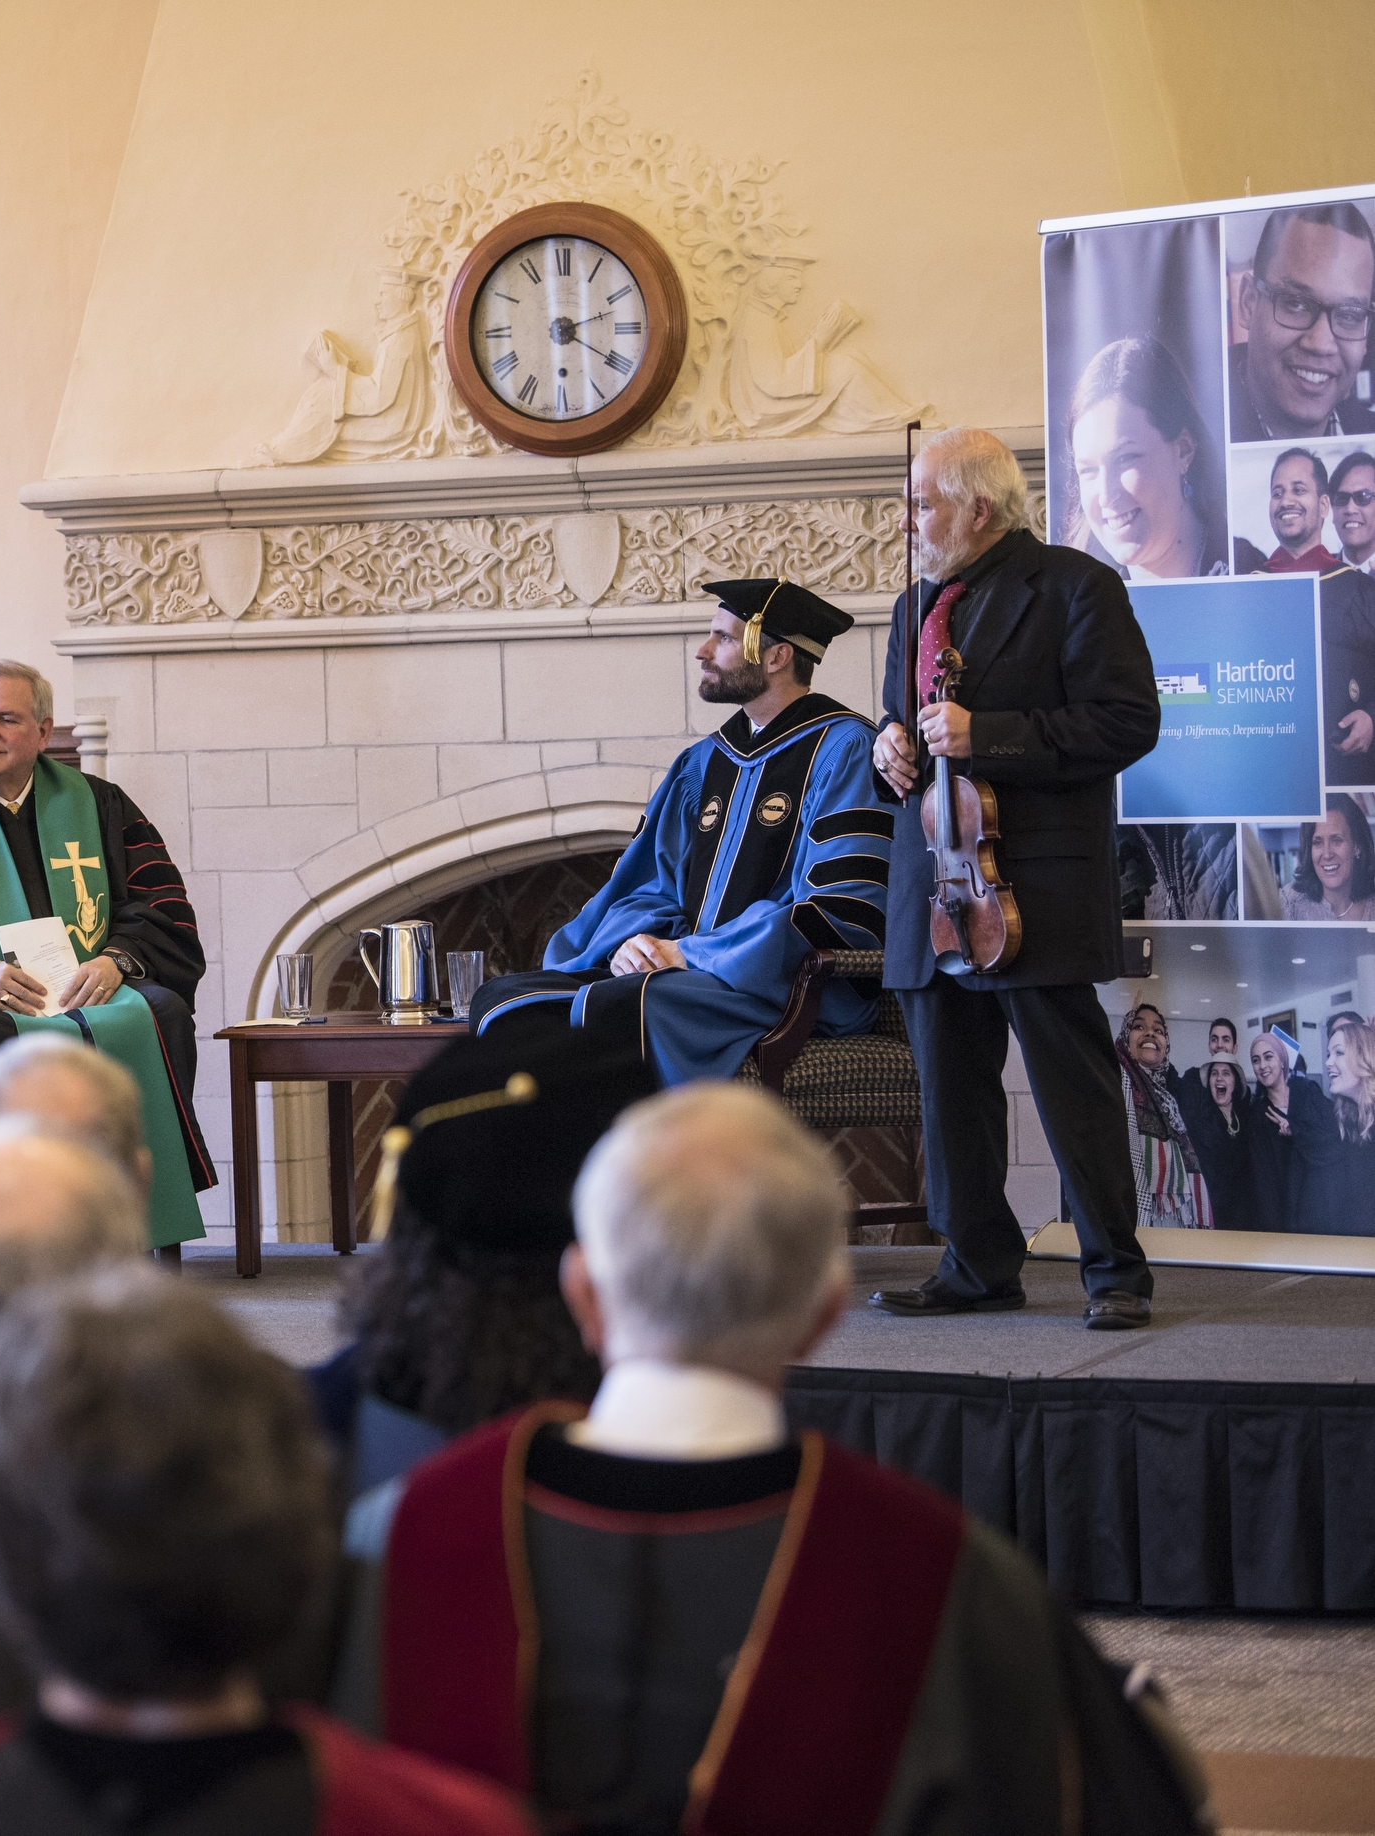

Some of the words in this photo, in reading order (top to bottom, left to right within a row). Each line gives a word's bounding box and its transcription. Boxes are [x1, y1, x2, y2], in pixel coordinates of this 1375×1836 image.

[1216, 658, 1295, 683] Hartford
[1216, 686, 1296, 705] SEMINARY
[1158, 725, 1183, 740] oring
[1185, 724, 1231, 740] Differences,
[1233, 723, 1274, 738] Deepening
[1276, 722, 1297, 734] Faith
